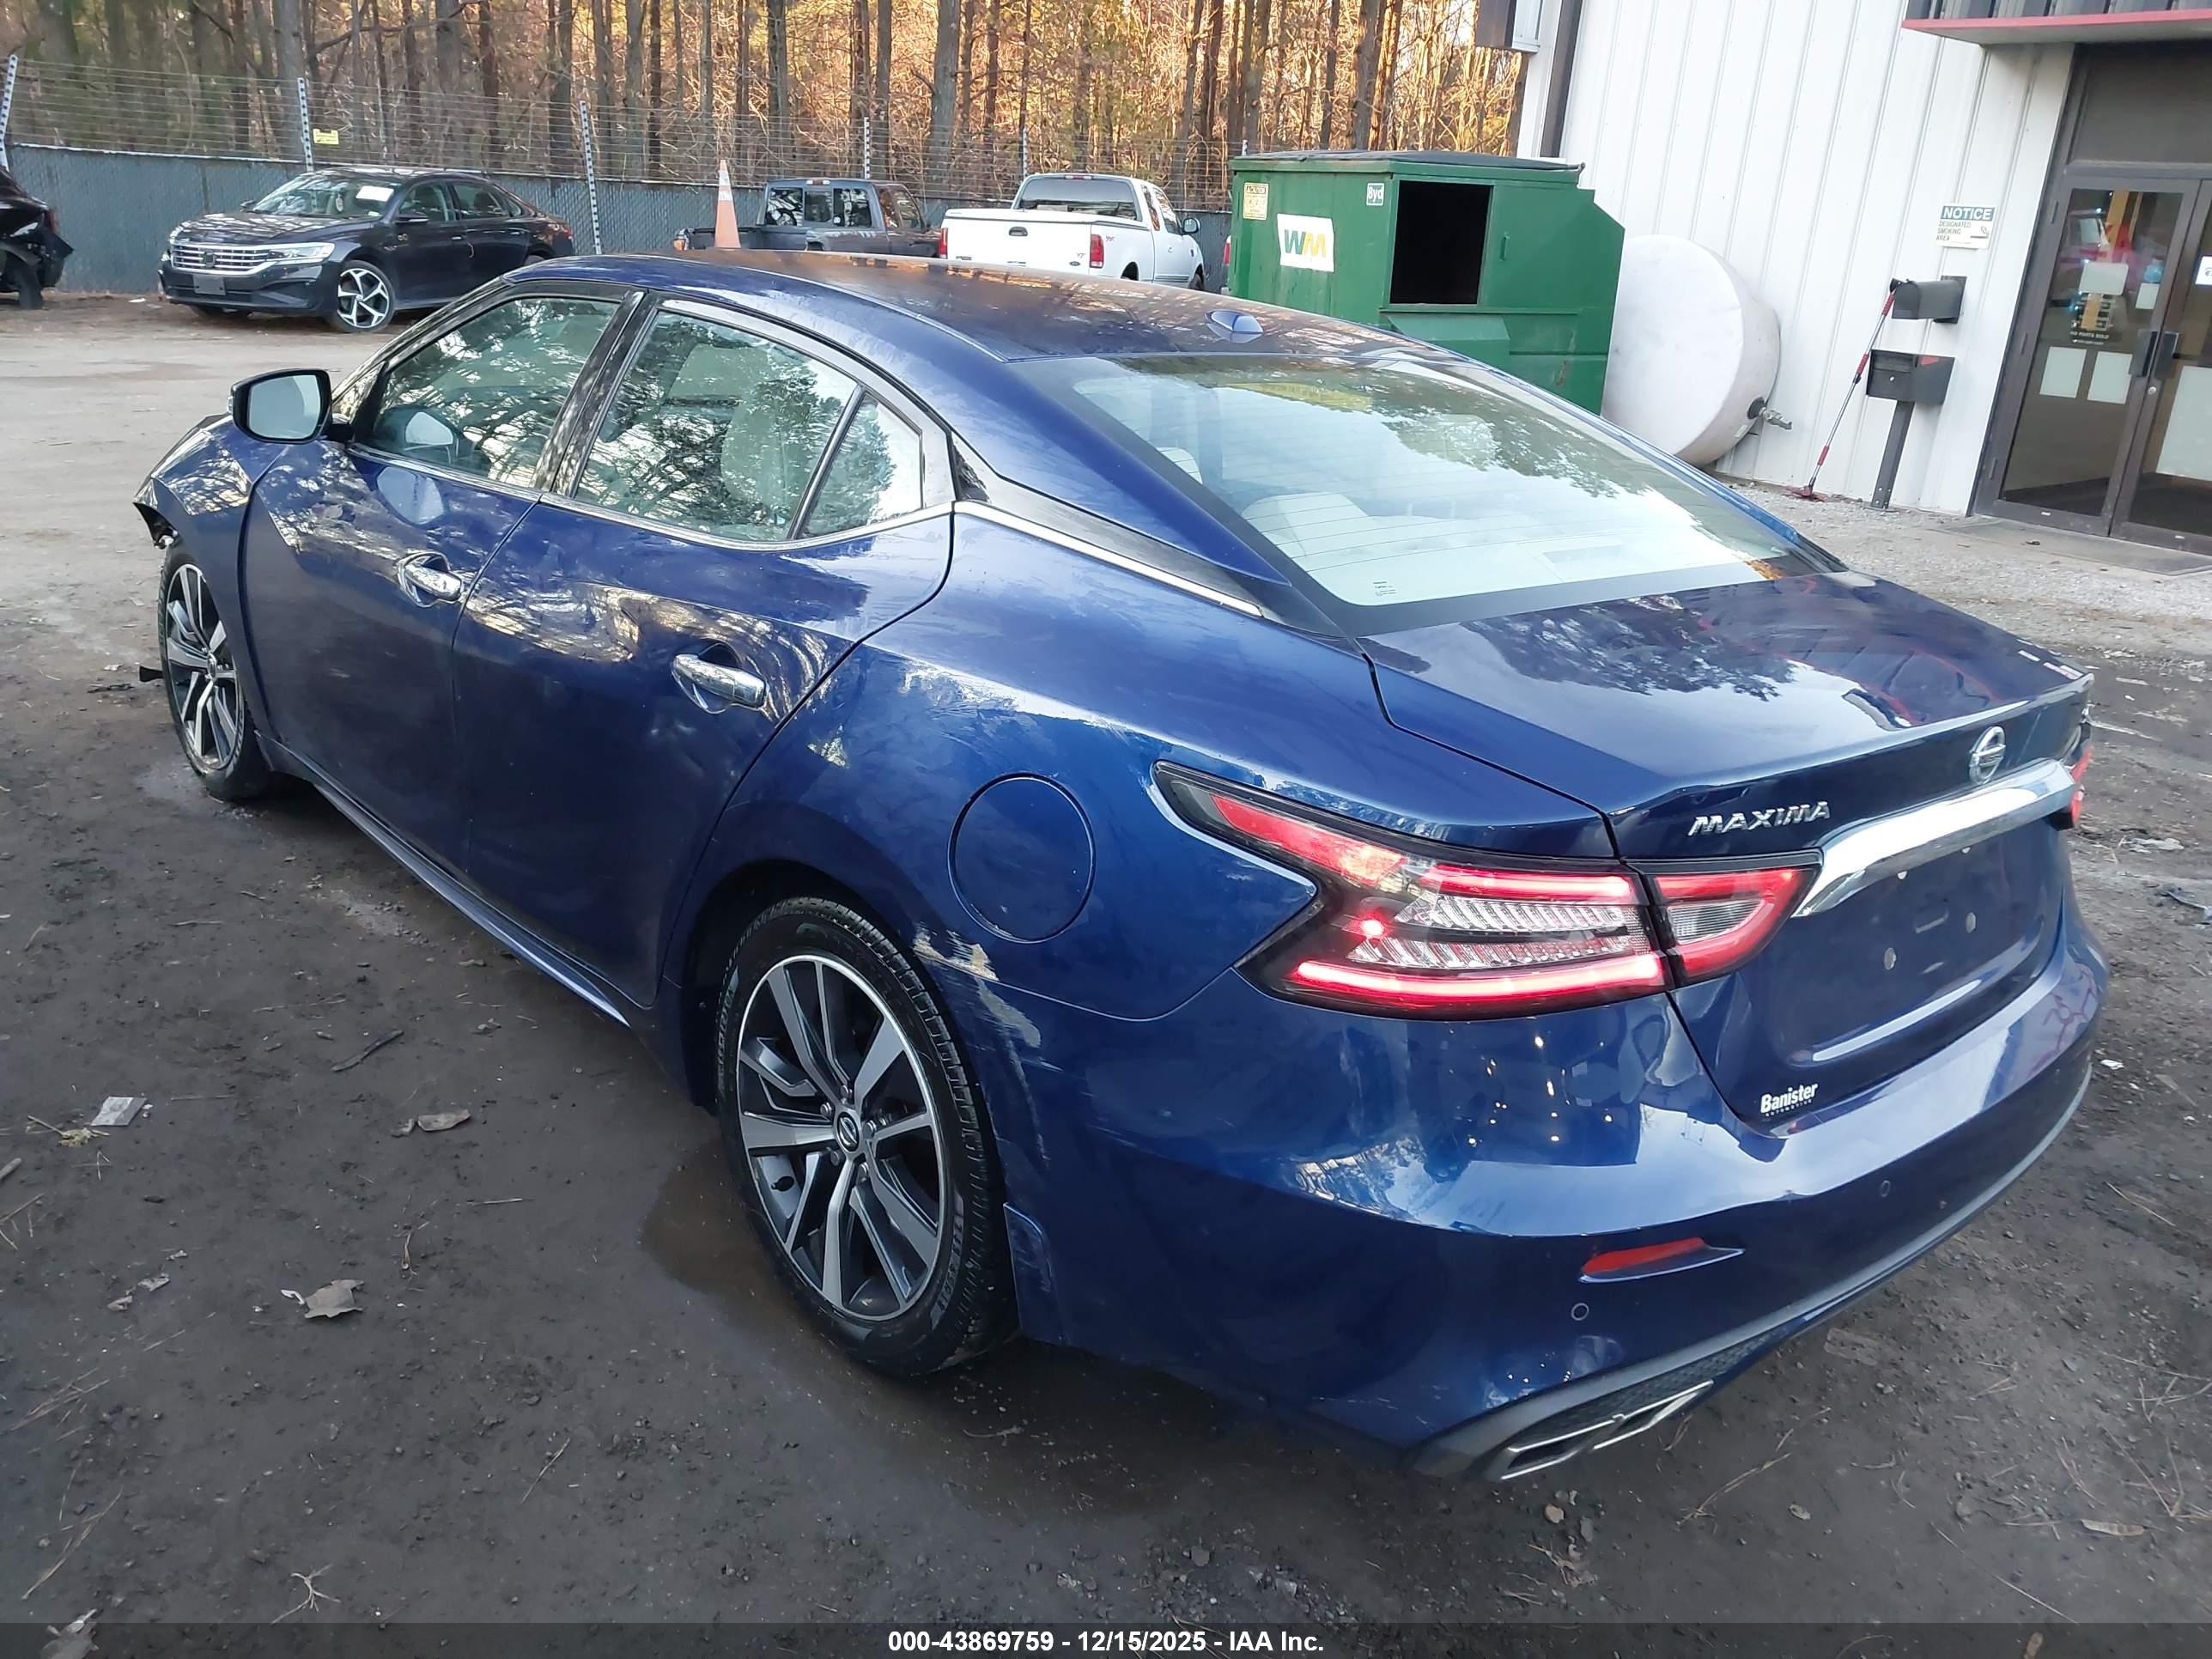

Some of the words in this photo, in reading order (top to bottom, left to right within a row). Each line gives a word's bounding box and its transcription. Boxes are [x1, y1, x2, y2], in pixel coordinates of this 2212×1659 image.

[1368, 185, 1382, 203] 8yd
[1942, 207, 1992, 220] NOTICE
[1284, 229, 1327, 258] WM
[1688, 801, 1831, 836] MAXIMA
[1760, 1083, 1819, 1114] Banister
